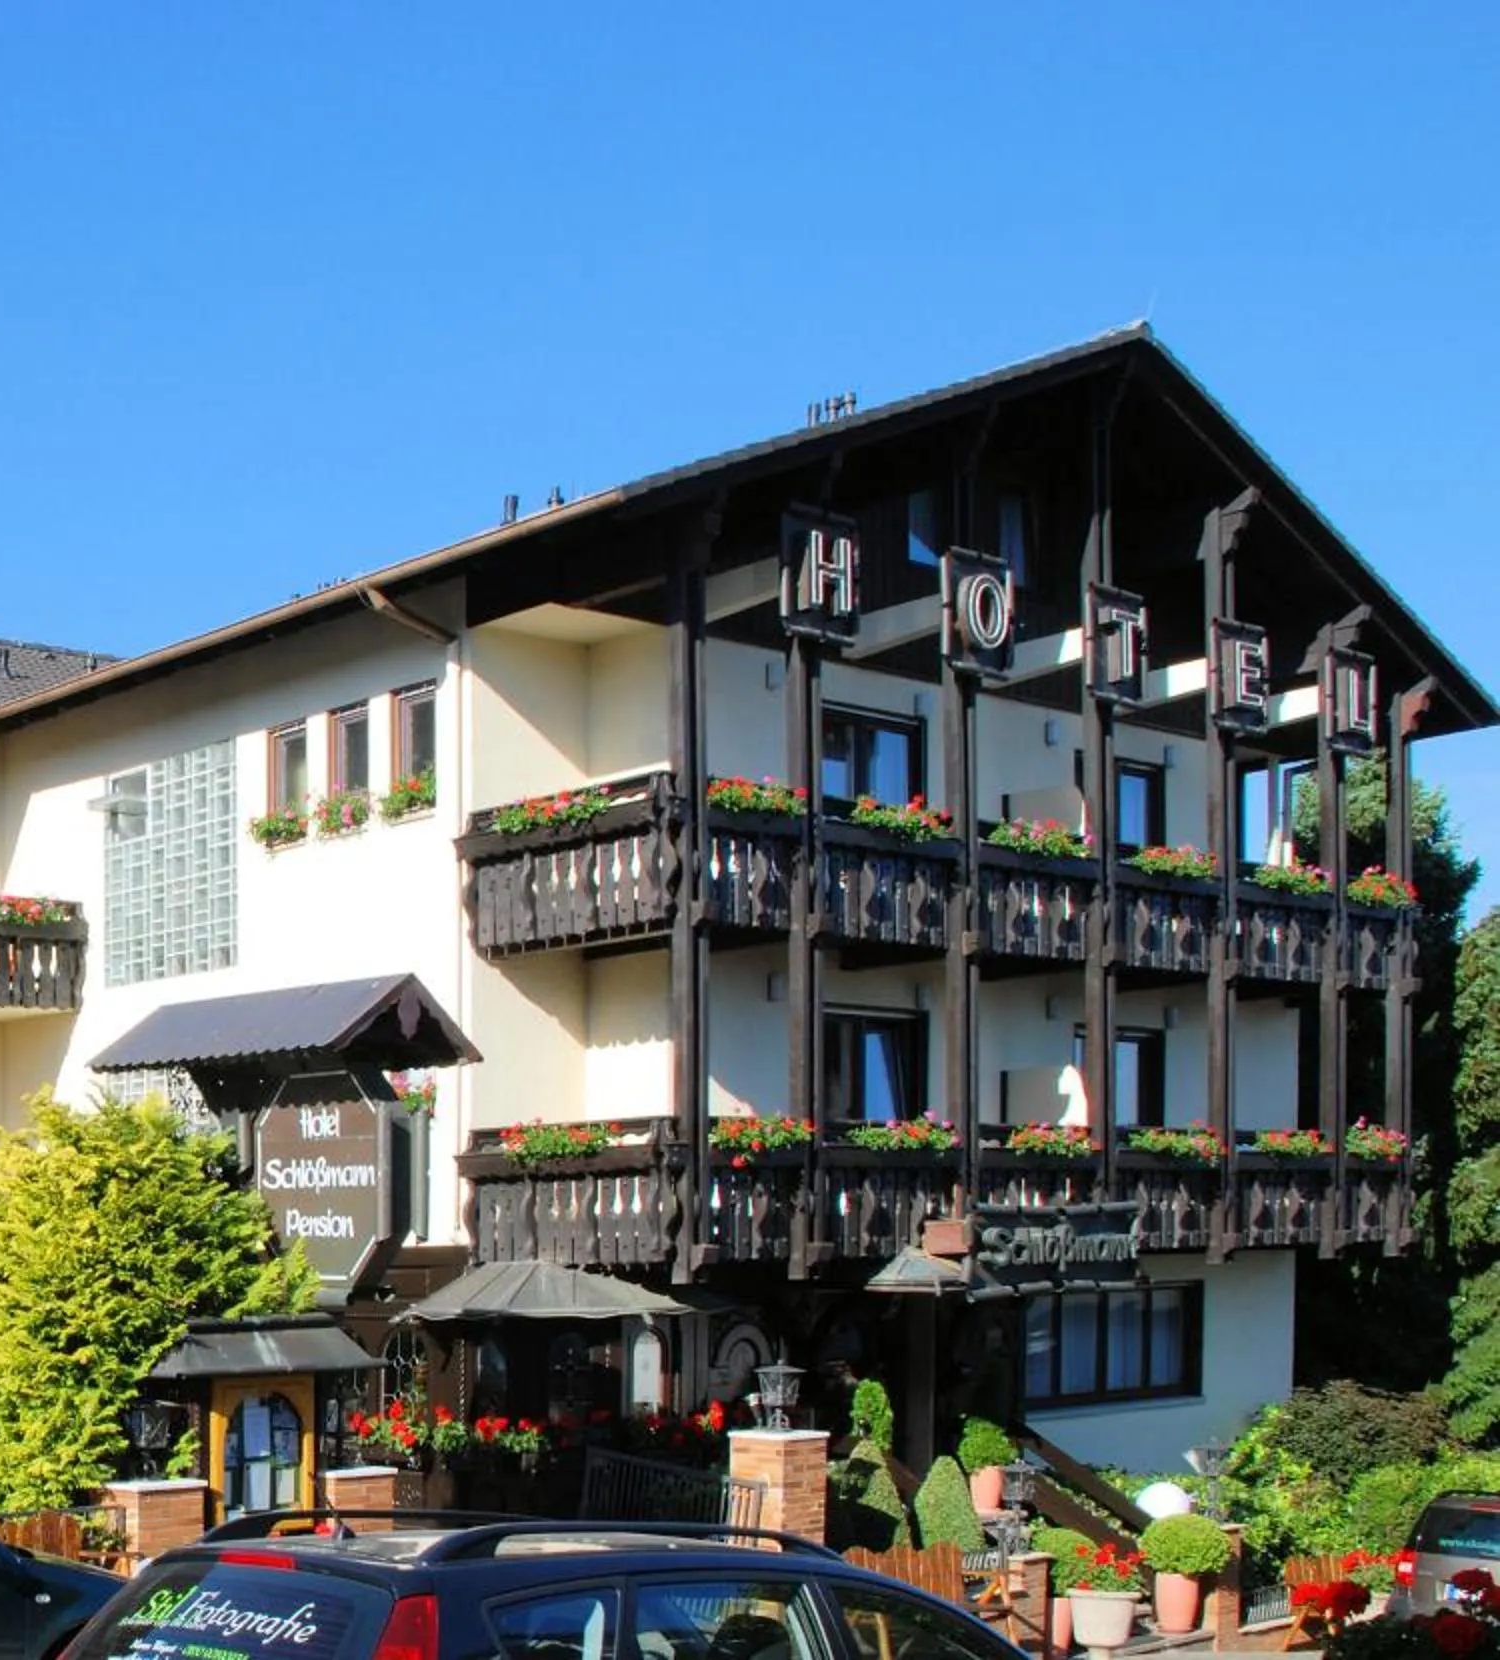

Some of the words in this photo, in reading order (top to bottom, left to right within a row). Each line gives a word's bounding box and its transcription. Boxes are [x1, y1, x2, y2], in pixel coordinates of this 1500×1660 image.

[799, 529, 1376, 731] HOTEL
[299, 1107, 341, 1139] Hotel
[262, 1156, 377, 1194] Schlößmann
[285, 1207, 355, 1238] Pension
[179, 1591, 318, 1645] Fotografie
